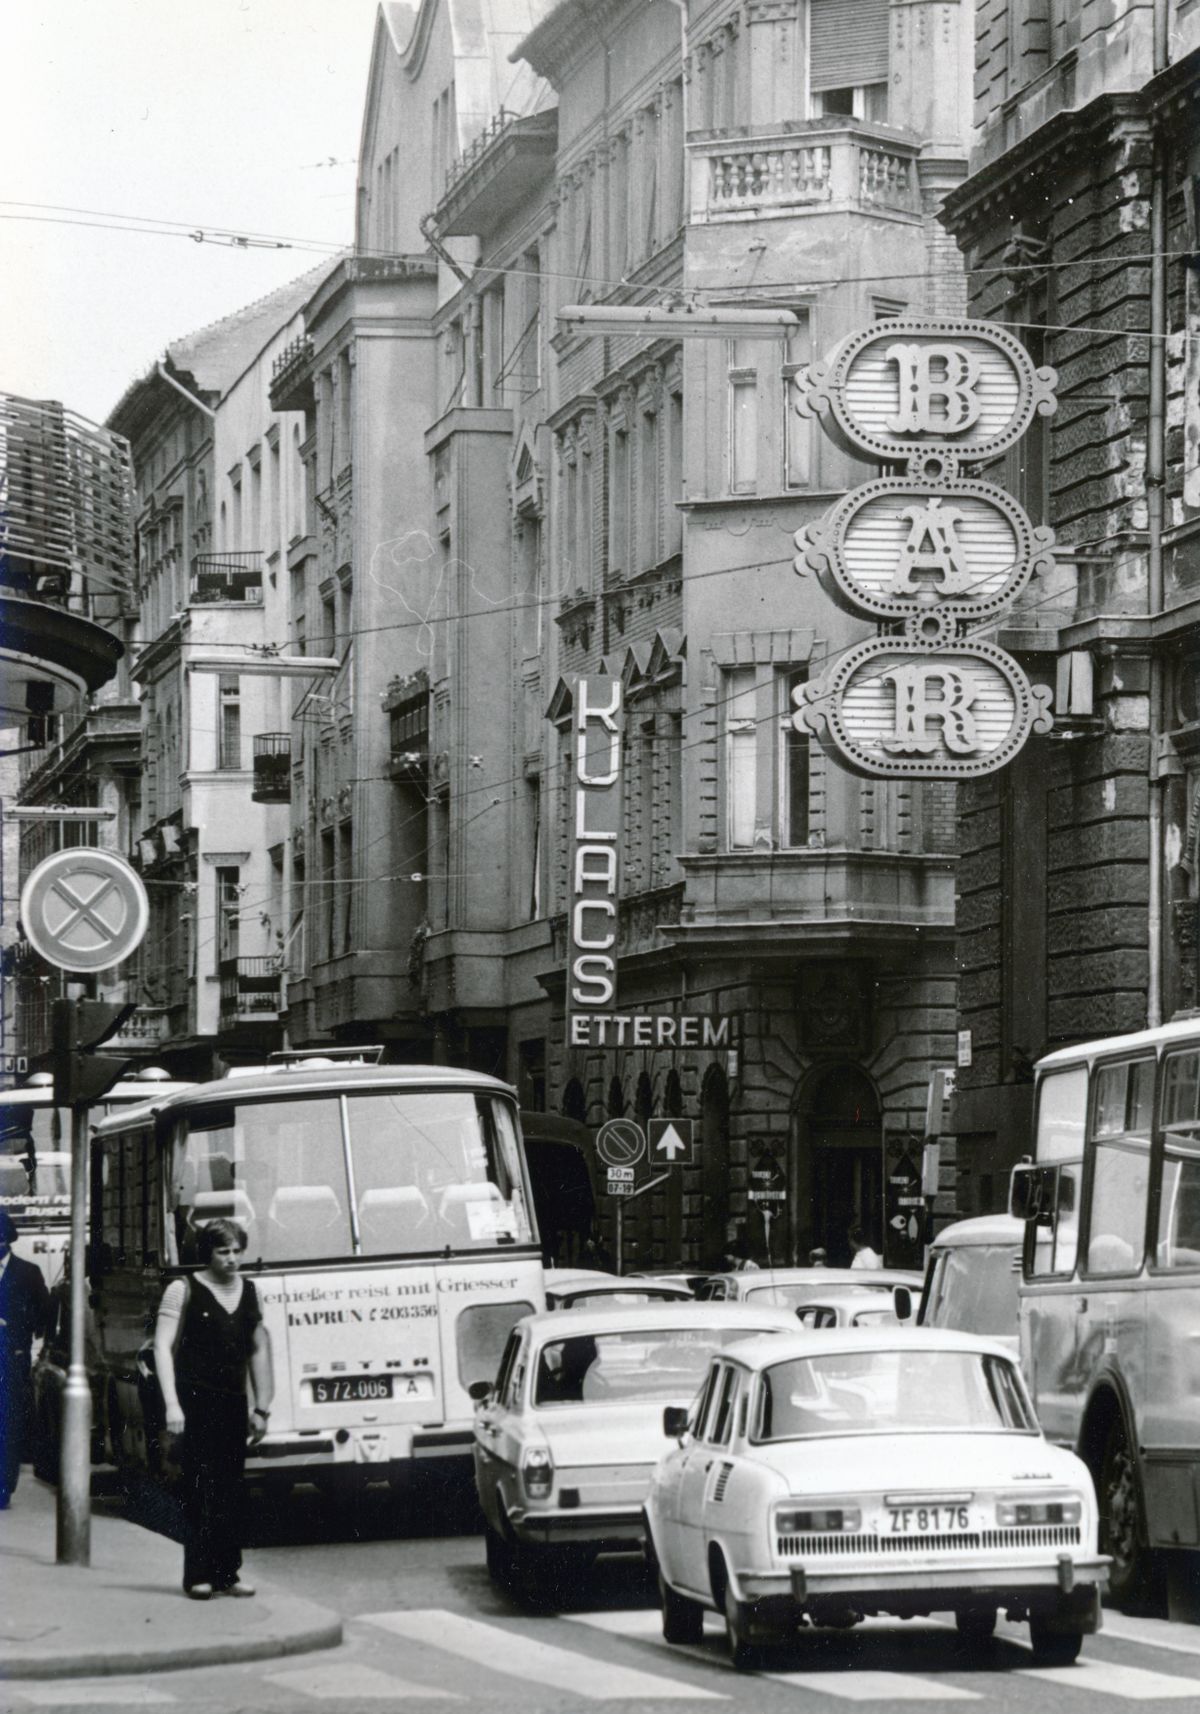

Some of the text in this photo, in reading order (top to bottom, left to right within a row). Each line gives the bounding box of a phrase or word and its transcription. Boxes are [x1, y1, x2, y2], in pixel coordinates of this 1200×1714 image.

[880, 342, 982, 754] BAR
[572, 680, 621, 1004] KULACS
[571, 1015, 729, 1046] ETTEREM
[610, 1168, 622, 1178] 30
[263, 1286, 343, 1304] enießer
[348, 1284, 393, 1300] reist
[397, 1281, 431, 1296] mit
[288, 1309, 363, 1327] KAPRUN
